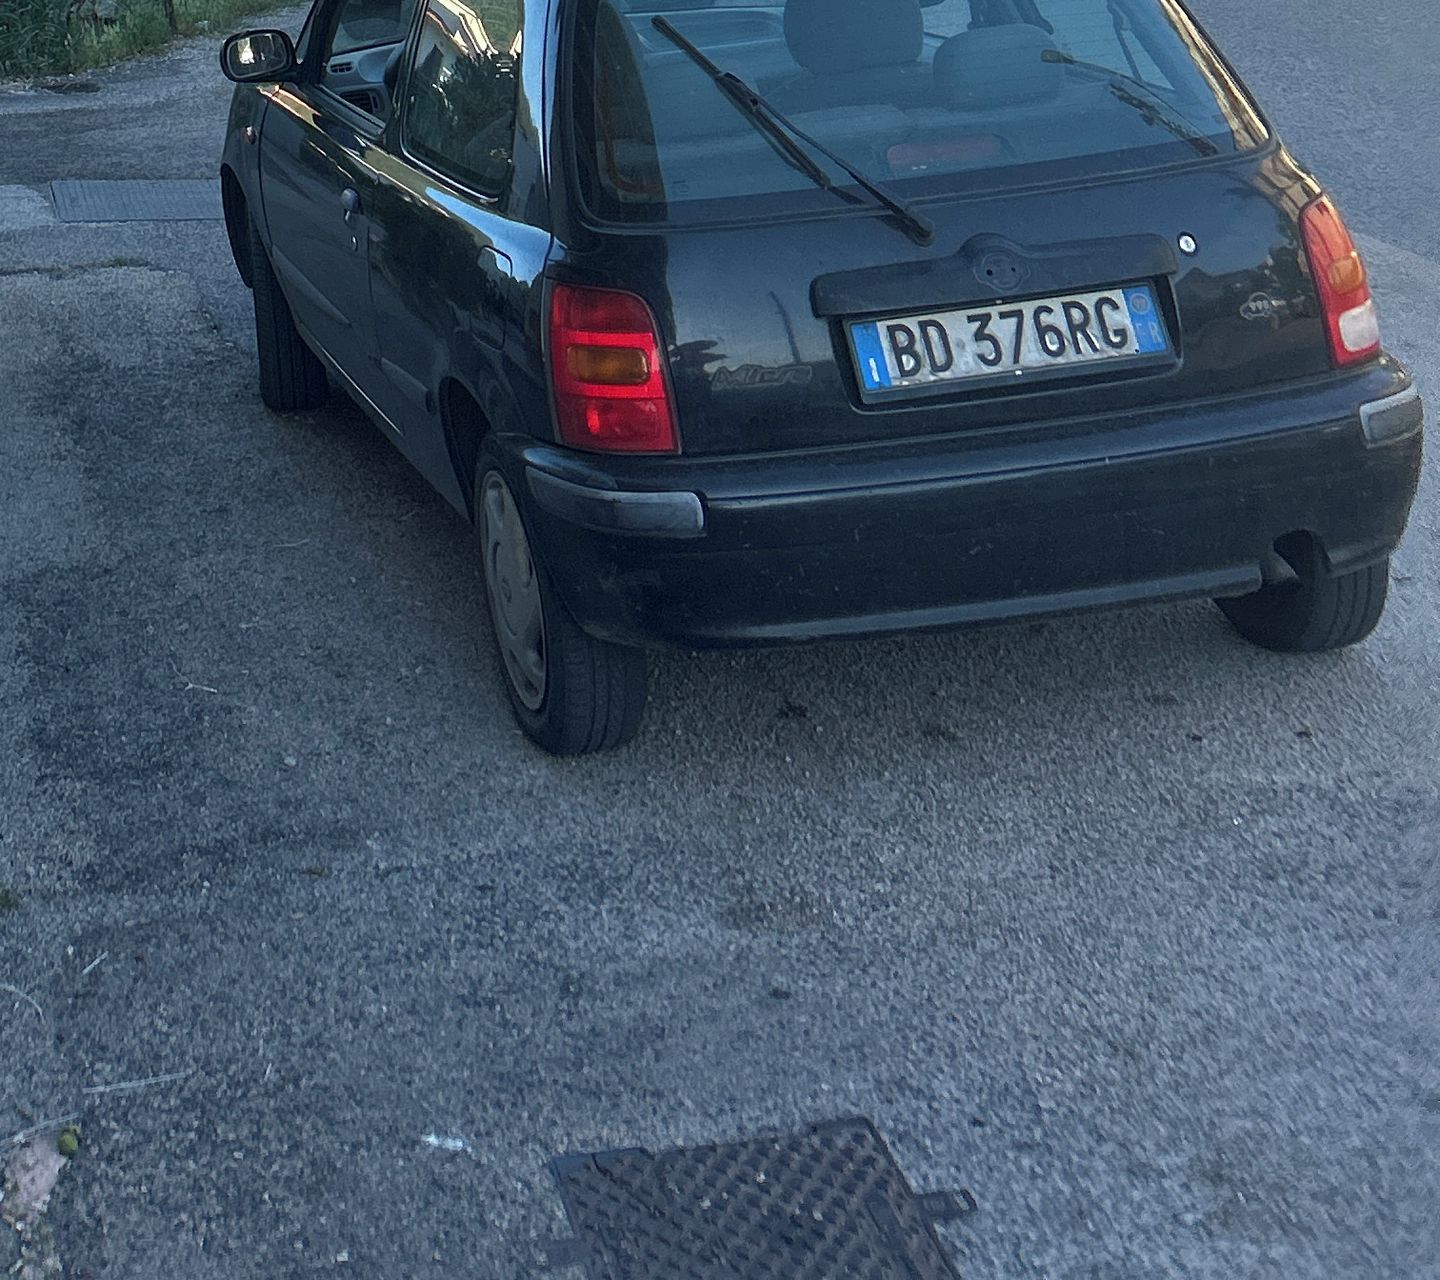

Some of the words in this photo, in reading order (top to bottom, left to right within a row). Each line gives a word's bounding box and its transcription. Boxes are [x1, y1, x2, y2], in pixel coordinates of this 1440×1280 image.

[868, 357, 880, 382] I
[886, 319, 954, 378] BD
[966, 295, 1129, 368] 376RG
